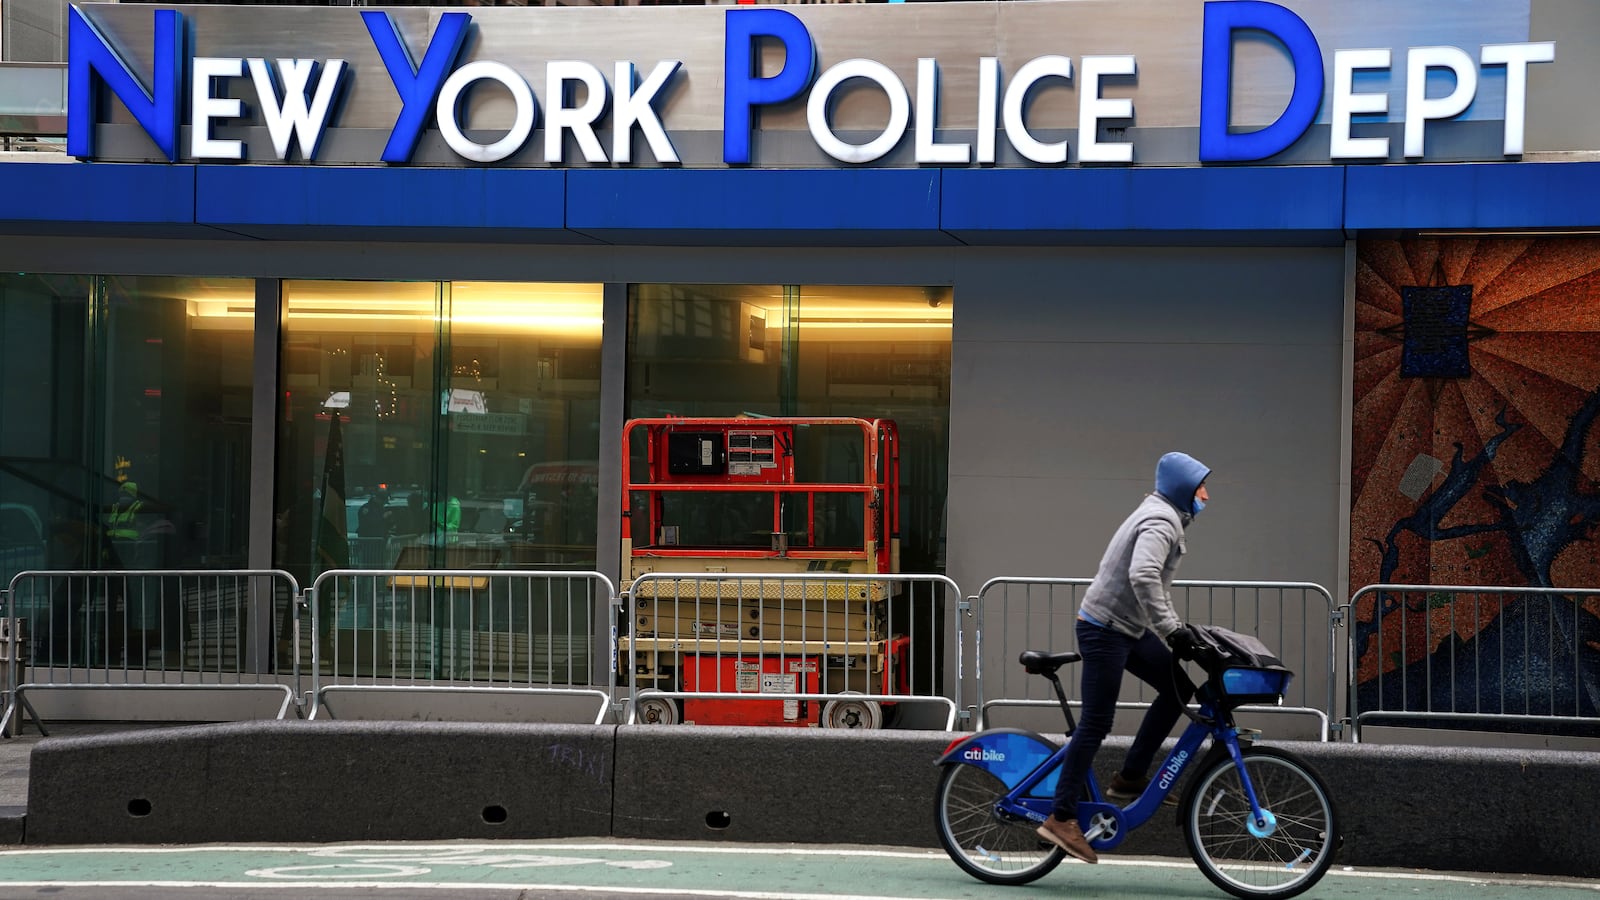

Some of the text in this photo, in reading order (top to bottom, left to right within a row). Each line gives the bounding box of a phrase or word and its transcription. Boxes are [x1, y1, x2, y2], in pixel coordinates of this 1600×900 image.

[963, 747, 1006, 761] citi bike
[1158, 750, 1189, 790] citi bike
